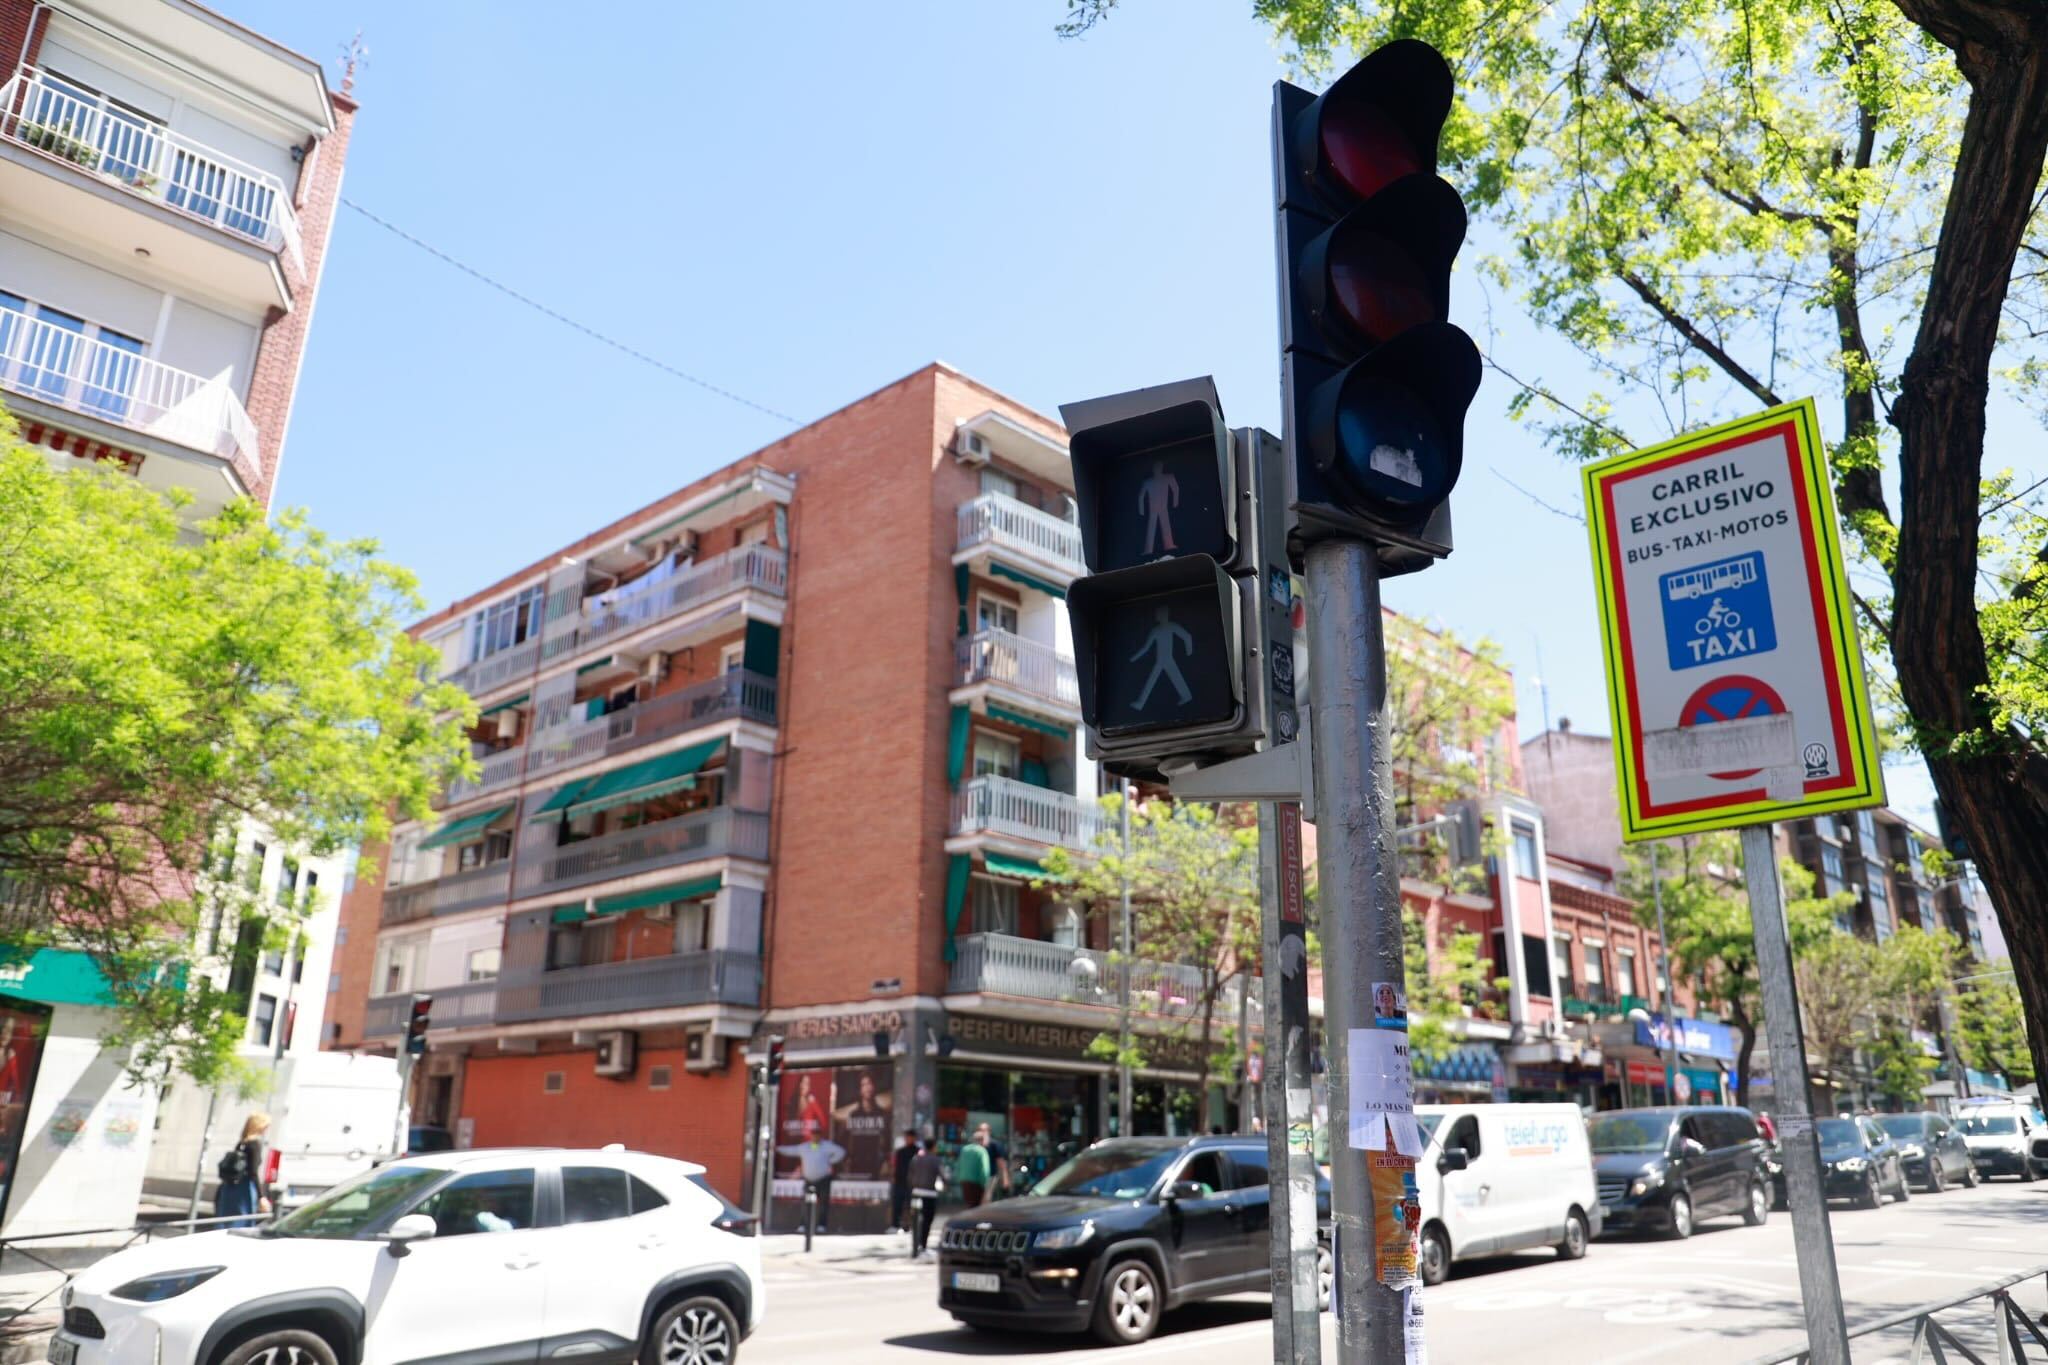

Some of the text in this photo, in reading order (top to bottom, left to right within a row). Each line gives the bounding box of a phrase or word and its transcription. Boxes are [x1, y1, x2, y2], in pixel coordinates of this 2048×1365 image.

[1652, 462, 1744, 501] CARRIL
[1631, 480, 1775, 534] EXCLUSIVO
[1686, 628, 1757, 663] TAXI
[840, 1010, 902, 1037] SANCHO
[947, 1016, 1091, 1050] PERFUMERIAS
[1365, 1102, 1381, 1110] LO
[1384, 1102, 1403, 1111] MAS
